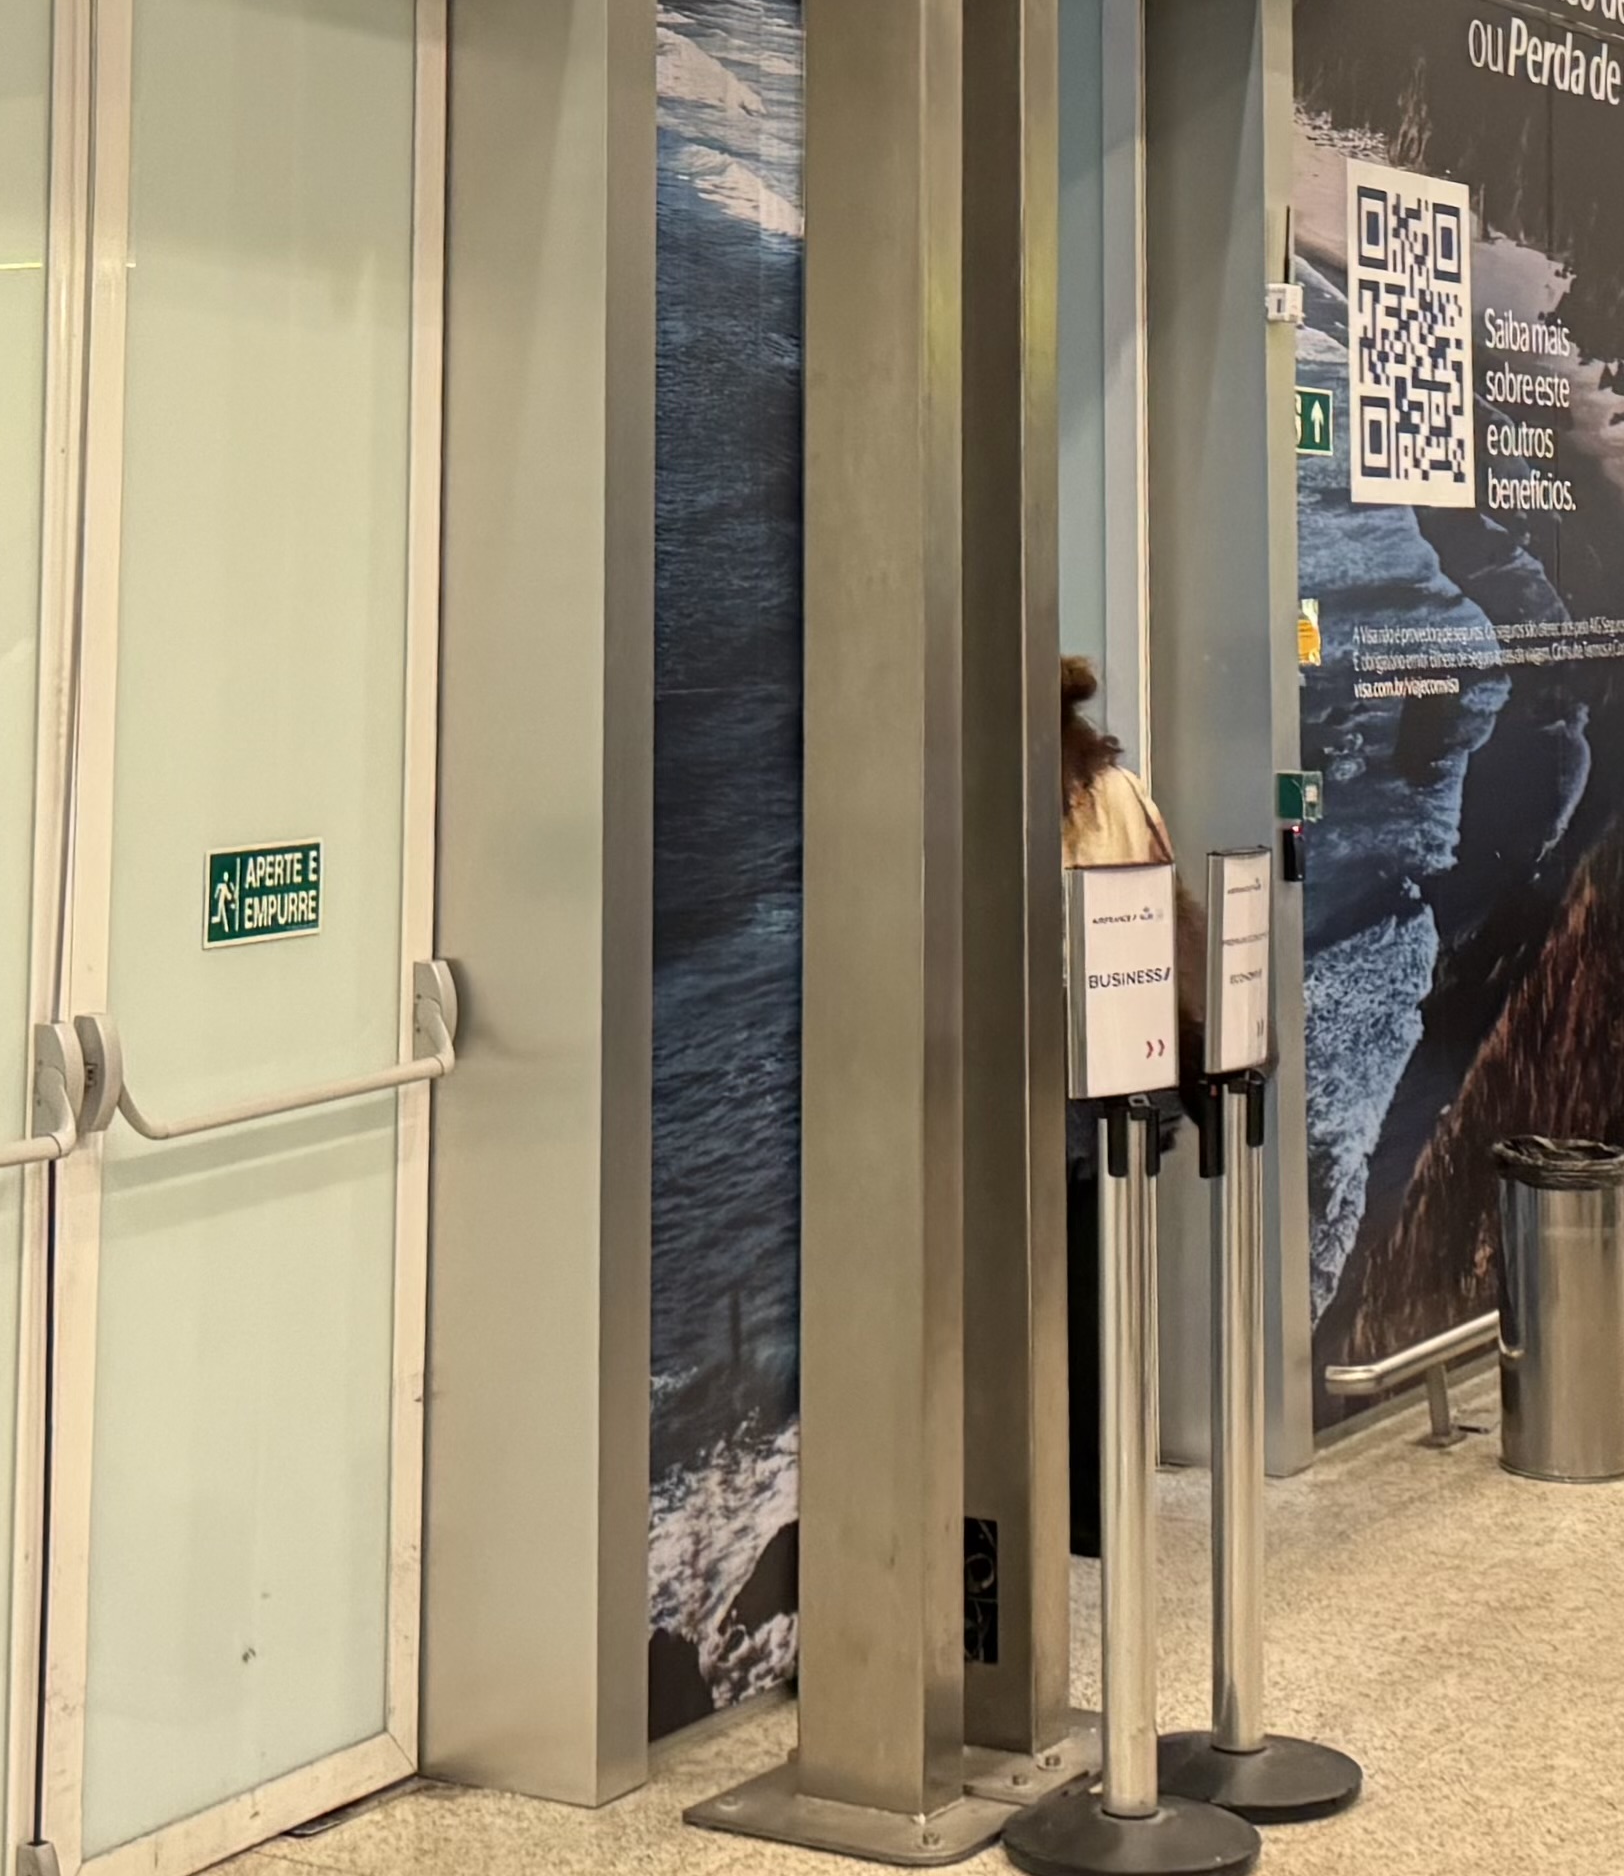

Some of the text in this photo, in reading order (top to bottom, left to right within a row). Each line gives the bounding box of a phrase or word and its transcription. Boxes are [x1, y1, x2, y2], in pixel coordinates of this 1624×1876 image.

[1468, 19, 1504, 73] ou
[1507, 17, 1585, 95] Perda
[1589, 43, 1621, 105] de
[1484, 307, 1571, 357] Saiba mais
[1485, 361, 1571, 409] sobre este
[1486, 421, 1554, 459] e outros
[245, 850, 318, 889] APERTE E
[244, 890, 317, 929] EMPURRE
[1088, 967, 1163, 989] BUSINESS
